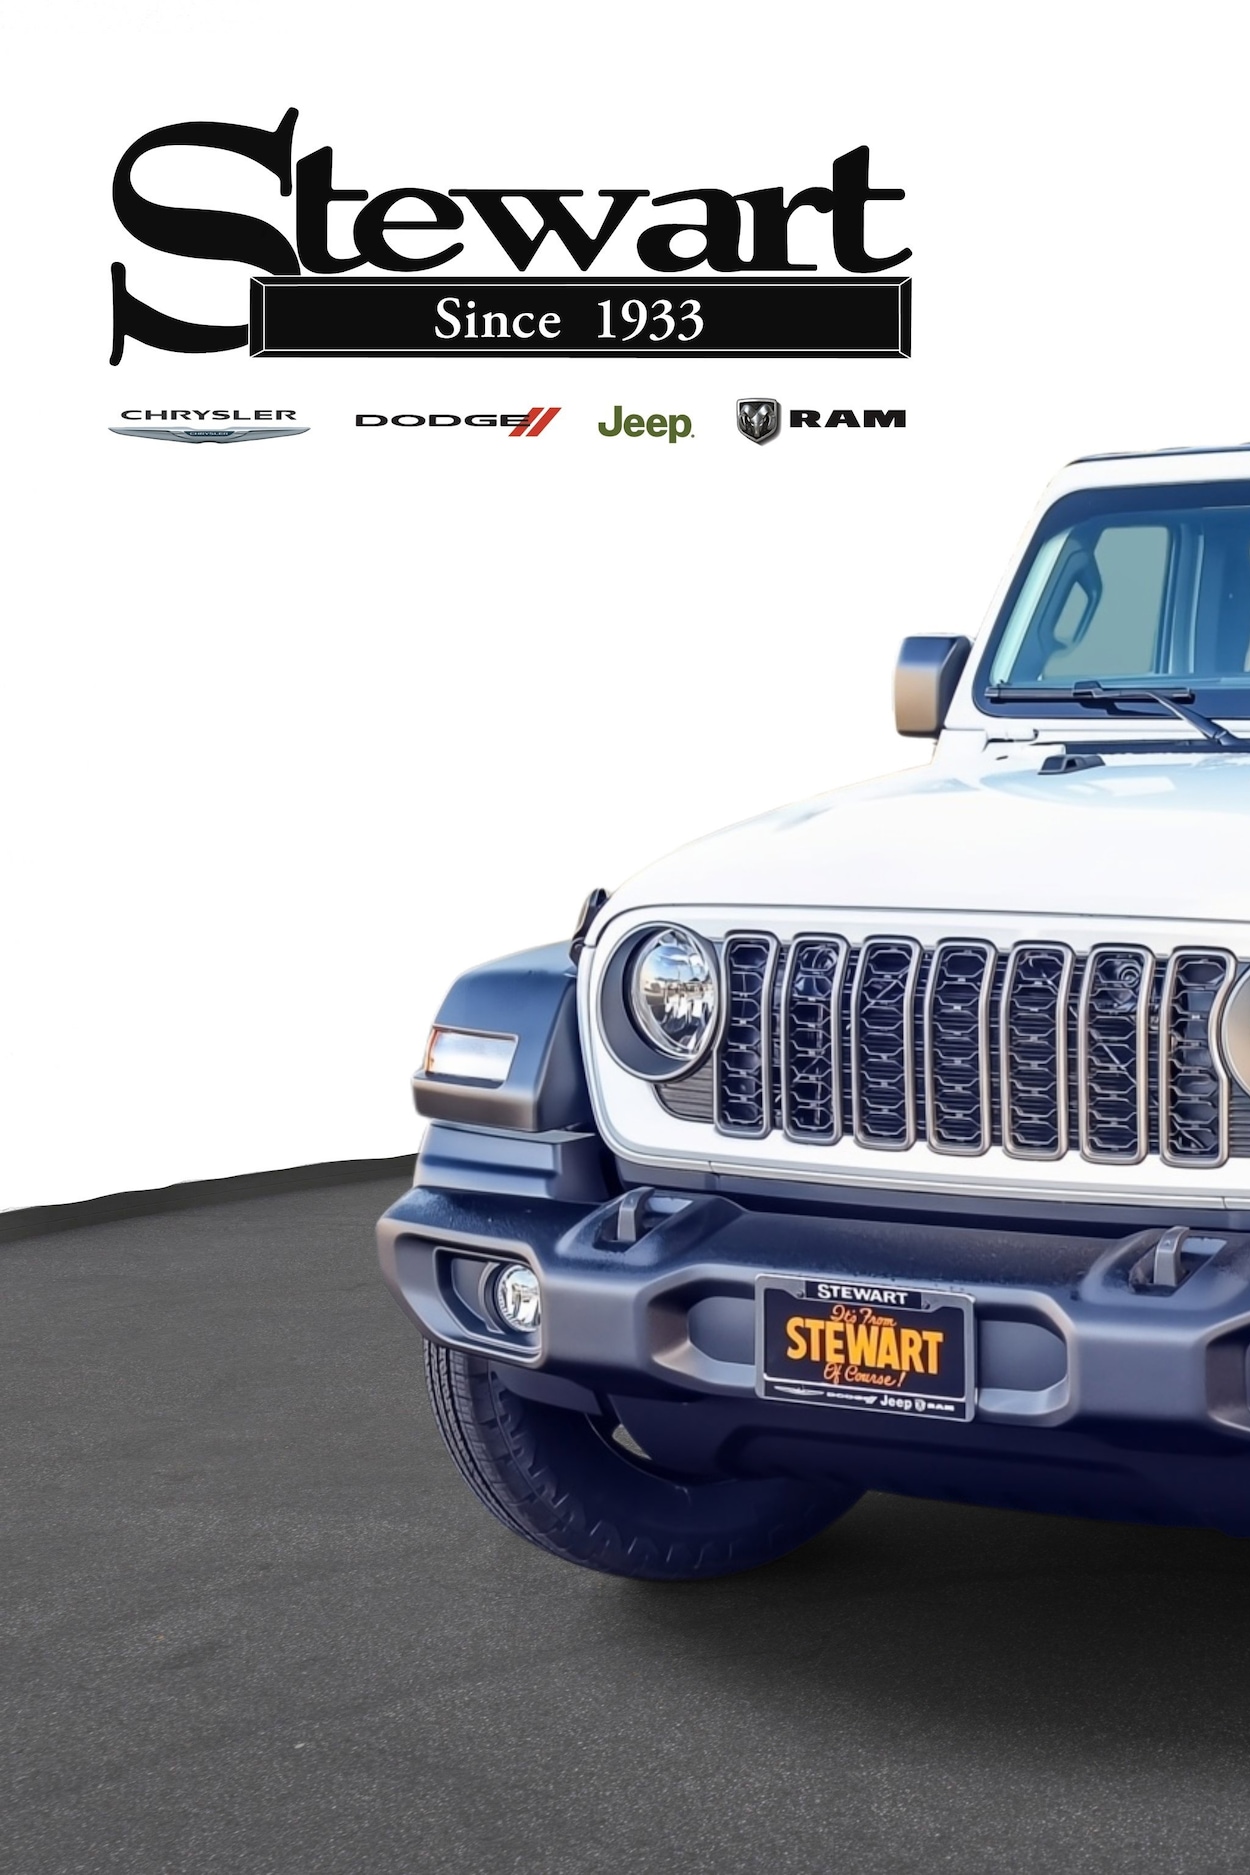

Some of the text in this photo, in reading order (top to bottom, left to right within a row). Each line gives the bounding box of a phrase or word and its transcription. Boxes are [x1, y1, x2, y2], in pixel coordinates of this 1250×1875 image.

[817, 1283, 909, 1305] STEWART
[859, 1307, 898, 1328] From
[786, 1316, 945, 1375] STEWART
[823, 1362, 843, 1386] Of
[880, 1394, 913, 1410] Jeep
